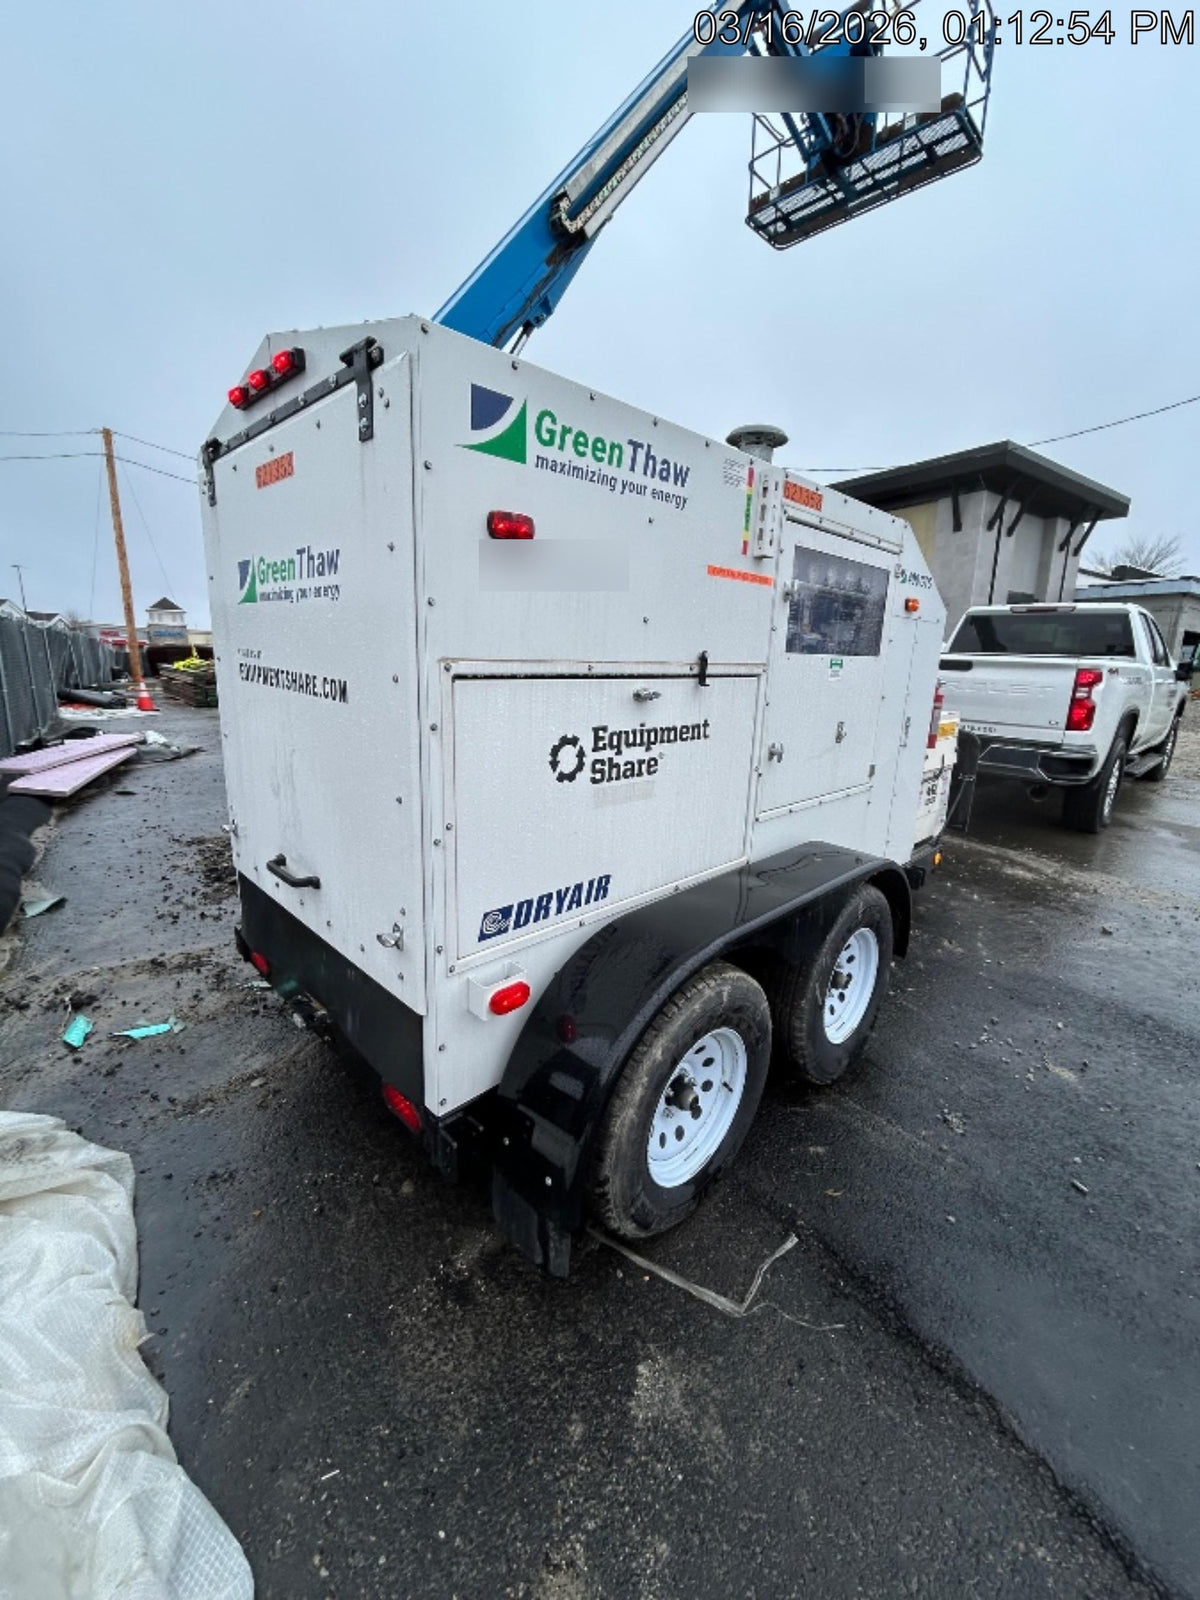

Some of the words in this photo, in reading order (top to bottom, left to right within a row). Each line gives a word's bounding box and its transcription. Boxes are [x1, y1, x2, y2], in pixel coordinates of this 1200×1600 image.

[534, 454, 617, 492] maximizing
[620, 478, 648, 495] your
[651, 486, 688, 510] energy
[591, 719, 711, 755] Equipment
[512, 874, 612, 930] DRYAIR
